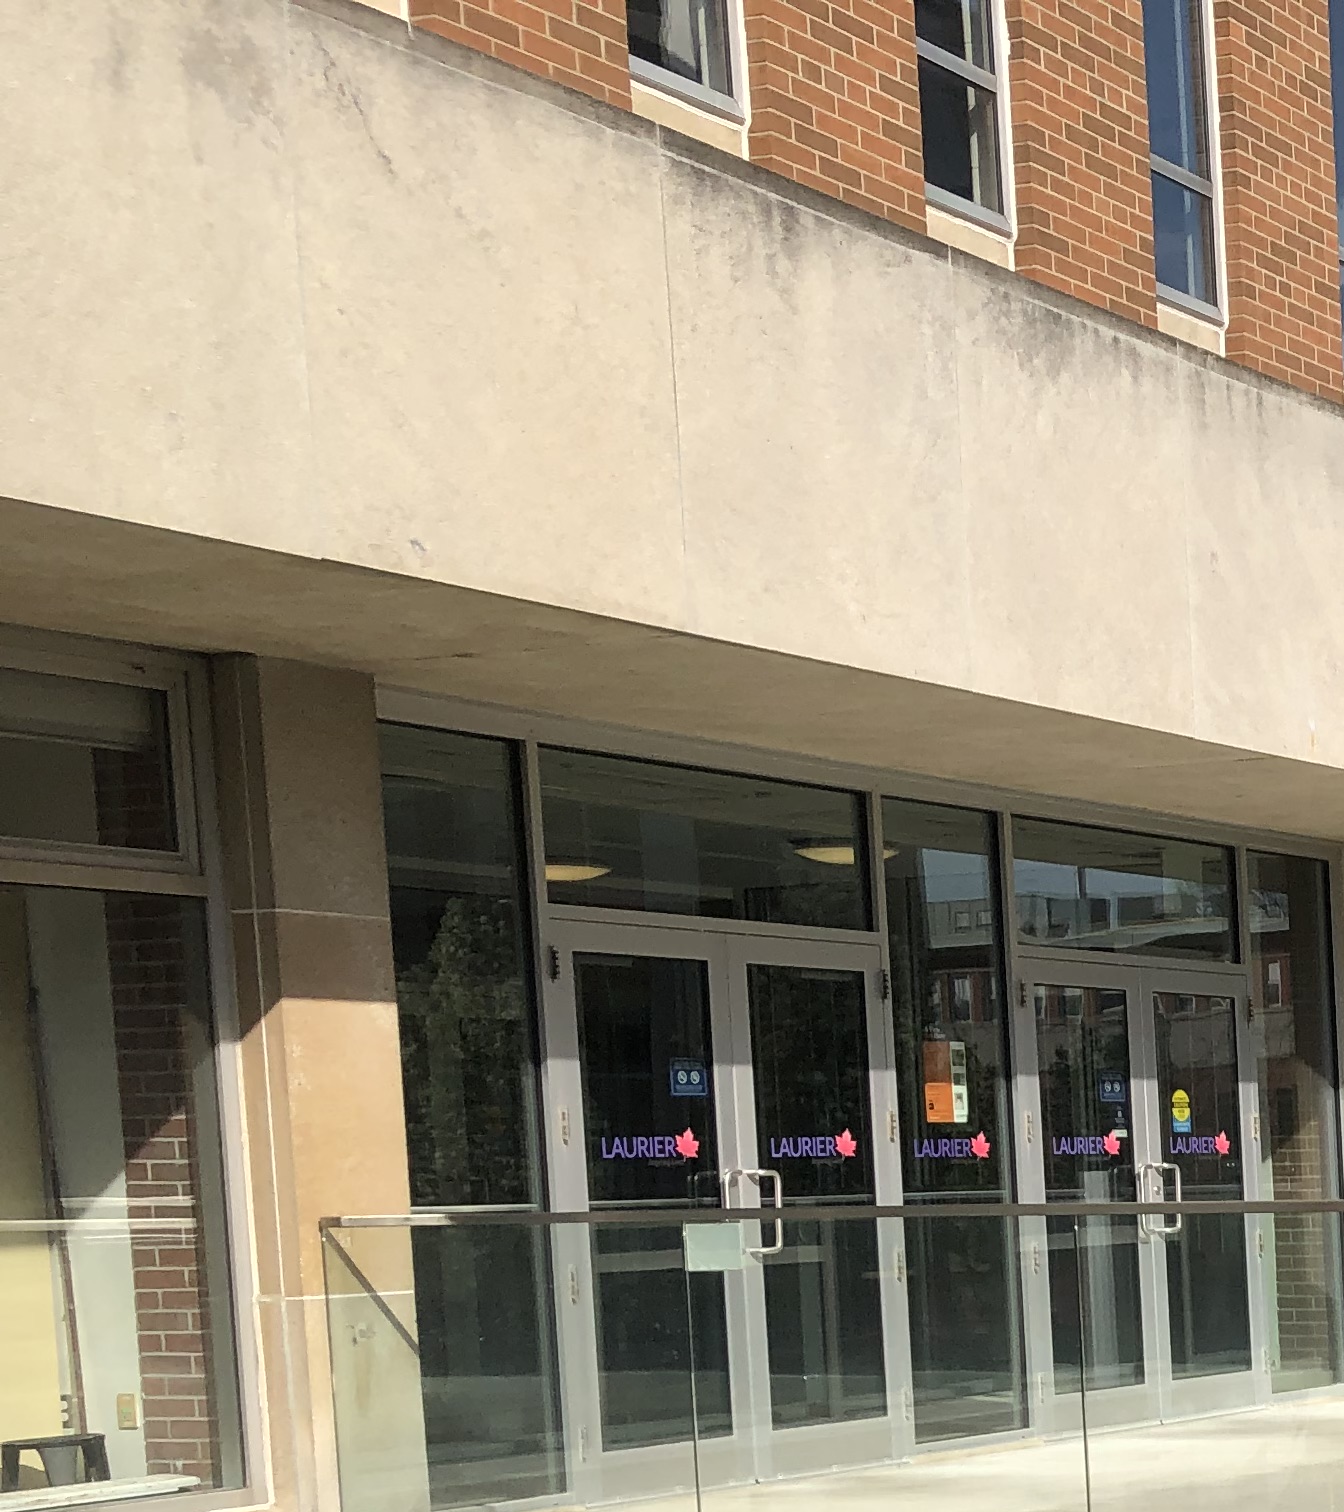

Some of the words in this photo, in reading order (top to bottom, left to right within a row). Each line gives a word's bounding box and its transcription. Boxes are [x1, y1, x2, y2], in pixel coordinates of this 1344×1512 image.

[601, 1136, 676, 1159] LAURIER
[770, 1137, 836, 1158] LAURIER
[914, 1138, 973, 1158] LAURIER
[1052, 1136, 1105, 1156] LAURIER
[1169, 1136, 1216, 1155] LAURIER
